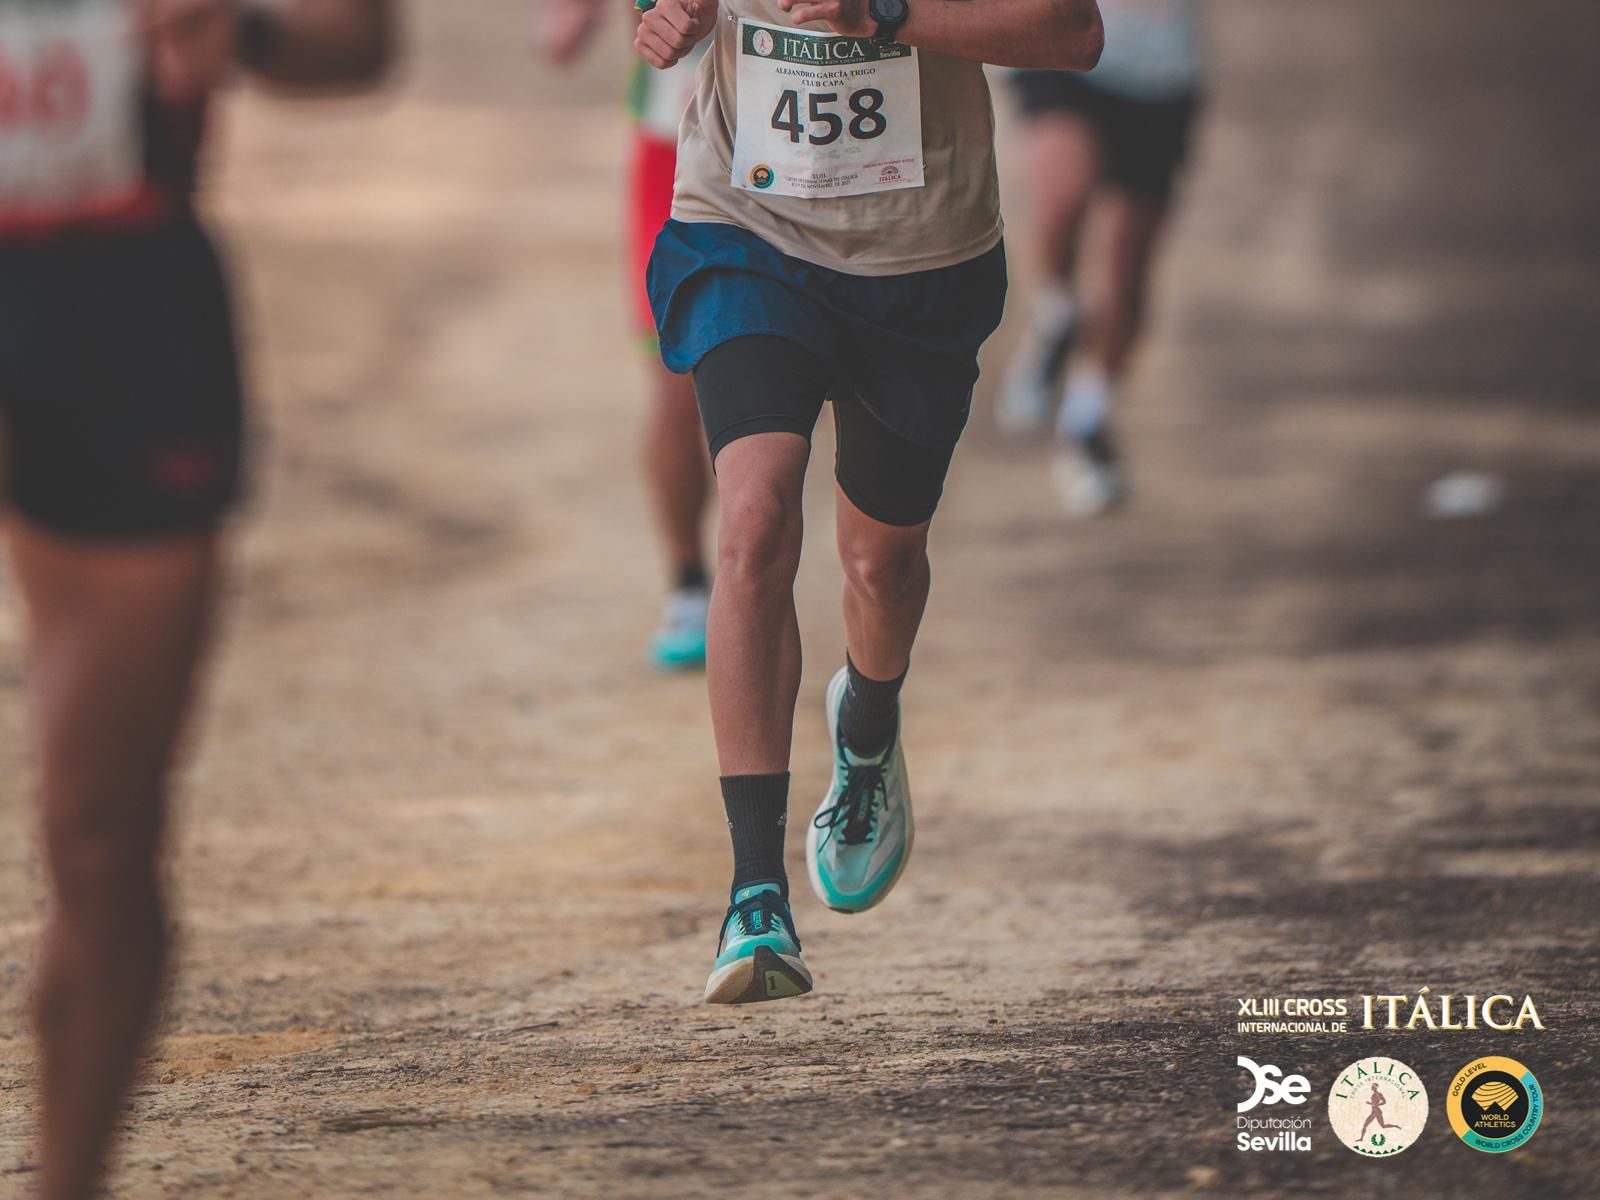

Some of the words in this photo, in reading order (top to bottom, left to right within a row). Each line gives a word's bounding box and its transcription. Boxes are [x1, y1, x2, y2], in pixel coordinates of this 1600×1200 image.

[784, 38, 864, 60] ITÁLICA
[776, 67, 815, 78] ALEJANDRO
[816, 69, 848, 78] GARCÍA
[850, 68, 876, 77] TRIGO
[771, 88, 887, 146] 458
